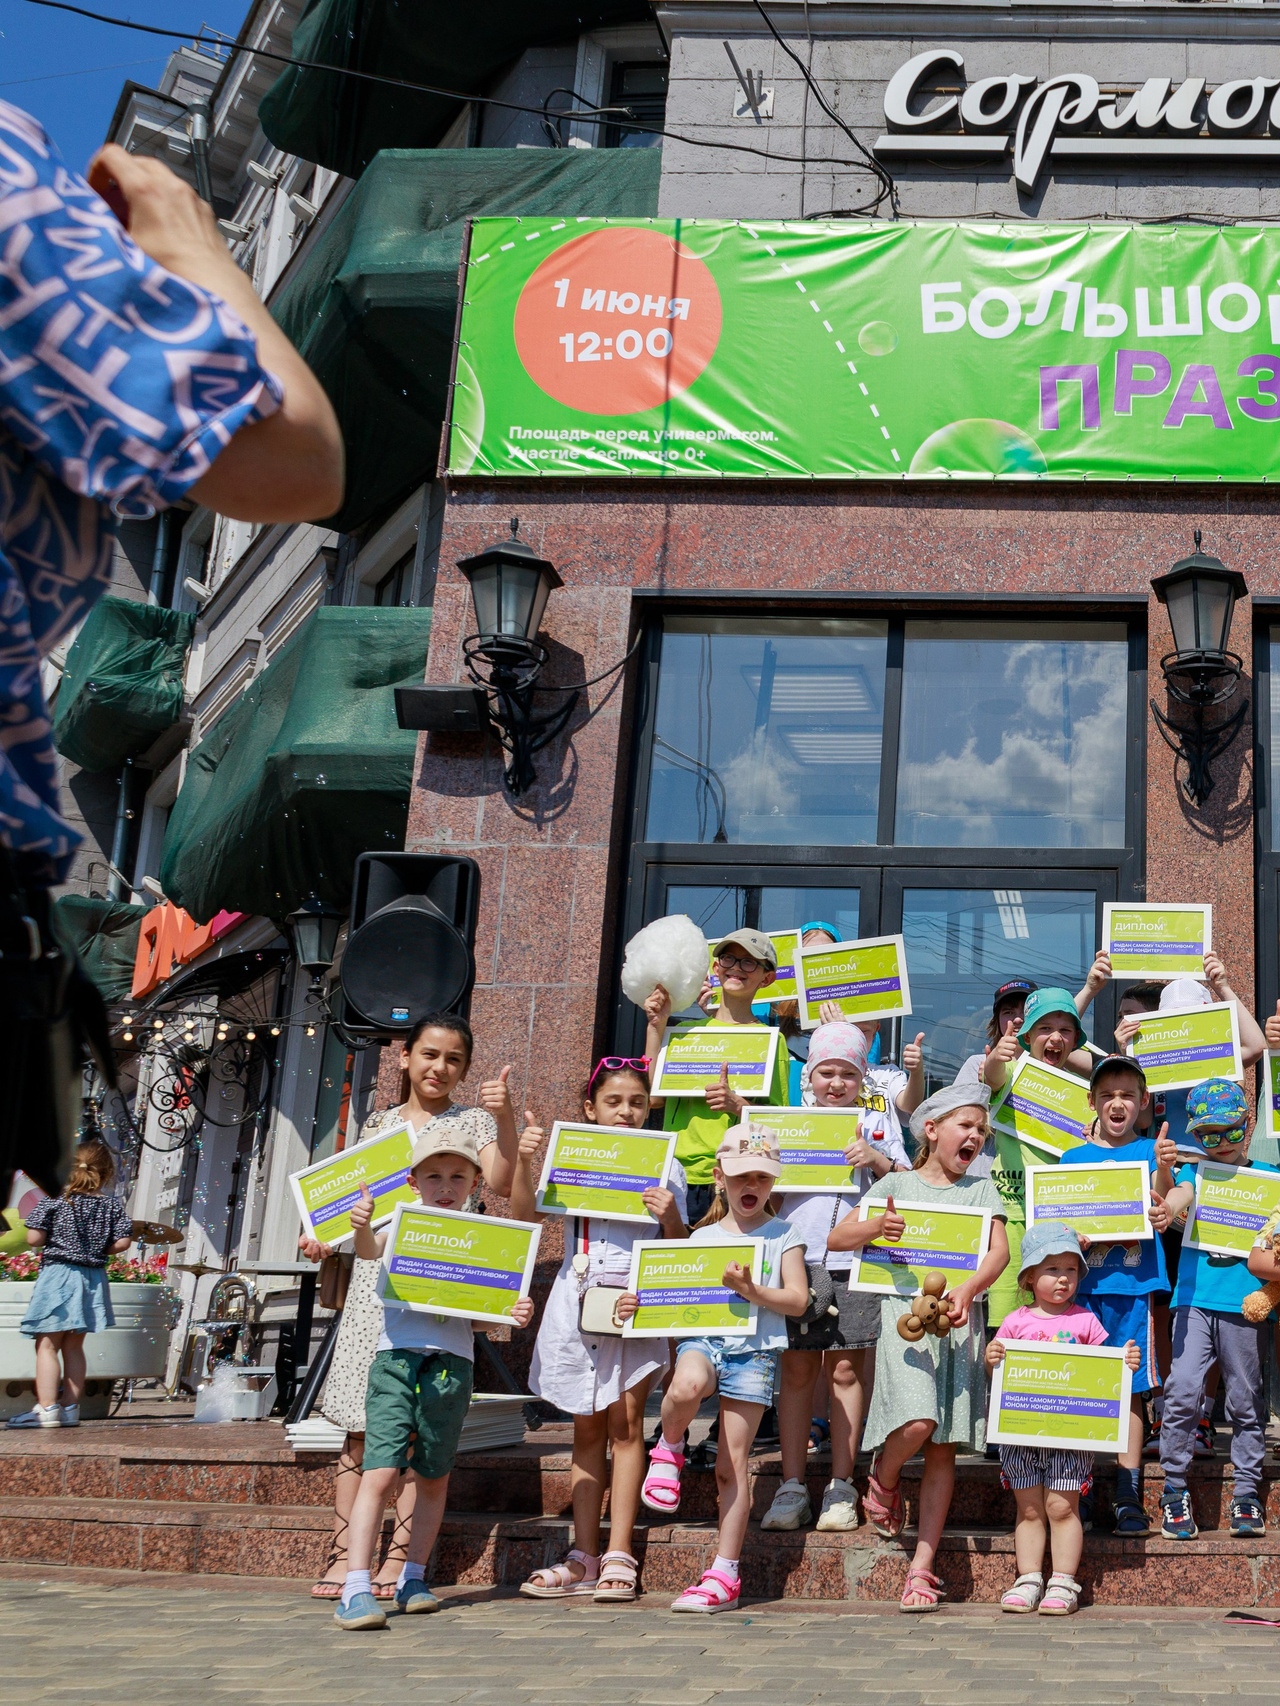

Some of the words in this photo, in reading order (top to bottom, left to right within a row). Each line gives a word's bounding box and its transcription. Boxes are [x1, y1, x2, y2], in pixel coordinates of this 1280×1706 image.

[553, 278, 571, 308] 1
[580, 287, 692, 321] июня
[558, 327, 674, 363] 12:00
[508, 426, 590, 443] Площадь
[596, 430, 650, 444] перед
[684, 448, 706, 460] 0+
[1000, 982, 1030, 993] PRINCESS
[559, 1146, 618, 1160] ДИПЛОМ
[309, 1165, 366, 1201] ДИПЛОМ
[1205, 1184, 1263, 1202] ДИПЛОМ
[402, 1230, 473, 1250] ДИПЛОМ
[890, 1256, 927, 1265] КОНДИТЕРУ
[917, 1252, 966, 1261] ТАЛАНТЛИВОМУ
[395, 1265, 424, 1275] ЮНОМУ
[424, 1269, 466, 1281] КОНДИТЕРУ
[397, 1259, 423, 1268] ВЫДАН
[423, 1262, 454, 1273] САМОМУ
[454, 1267, 510, 1280] ТАЛАНТЛИВОМУ
[643, 1263, 704, 1277] ДИПЛОМ
[664, 1296, 701, 1304] КОНДИТЕРУ
[1007, 1367, 1071, 1381] ДИПЛОМ
[1029, 1396, 1057, 1405] САМОМУ
[1057, 1399, 1108, 1409] ТАЛАНТЛИВОМУ
[1030, 1403, 1068, 1412] КОНДИТЕРУ
